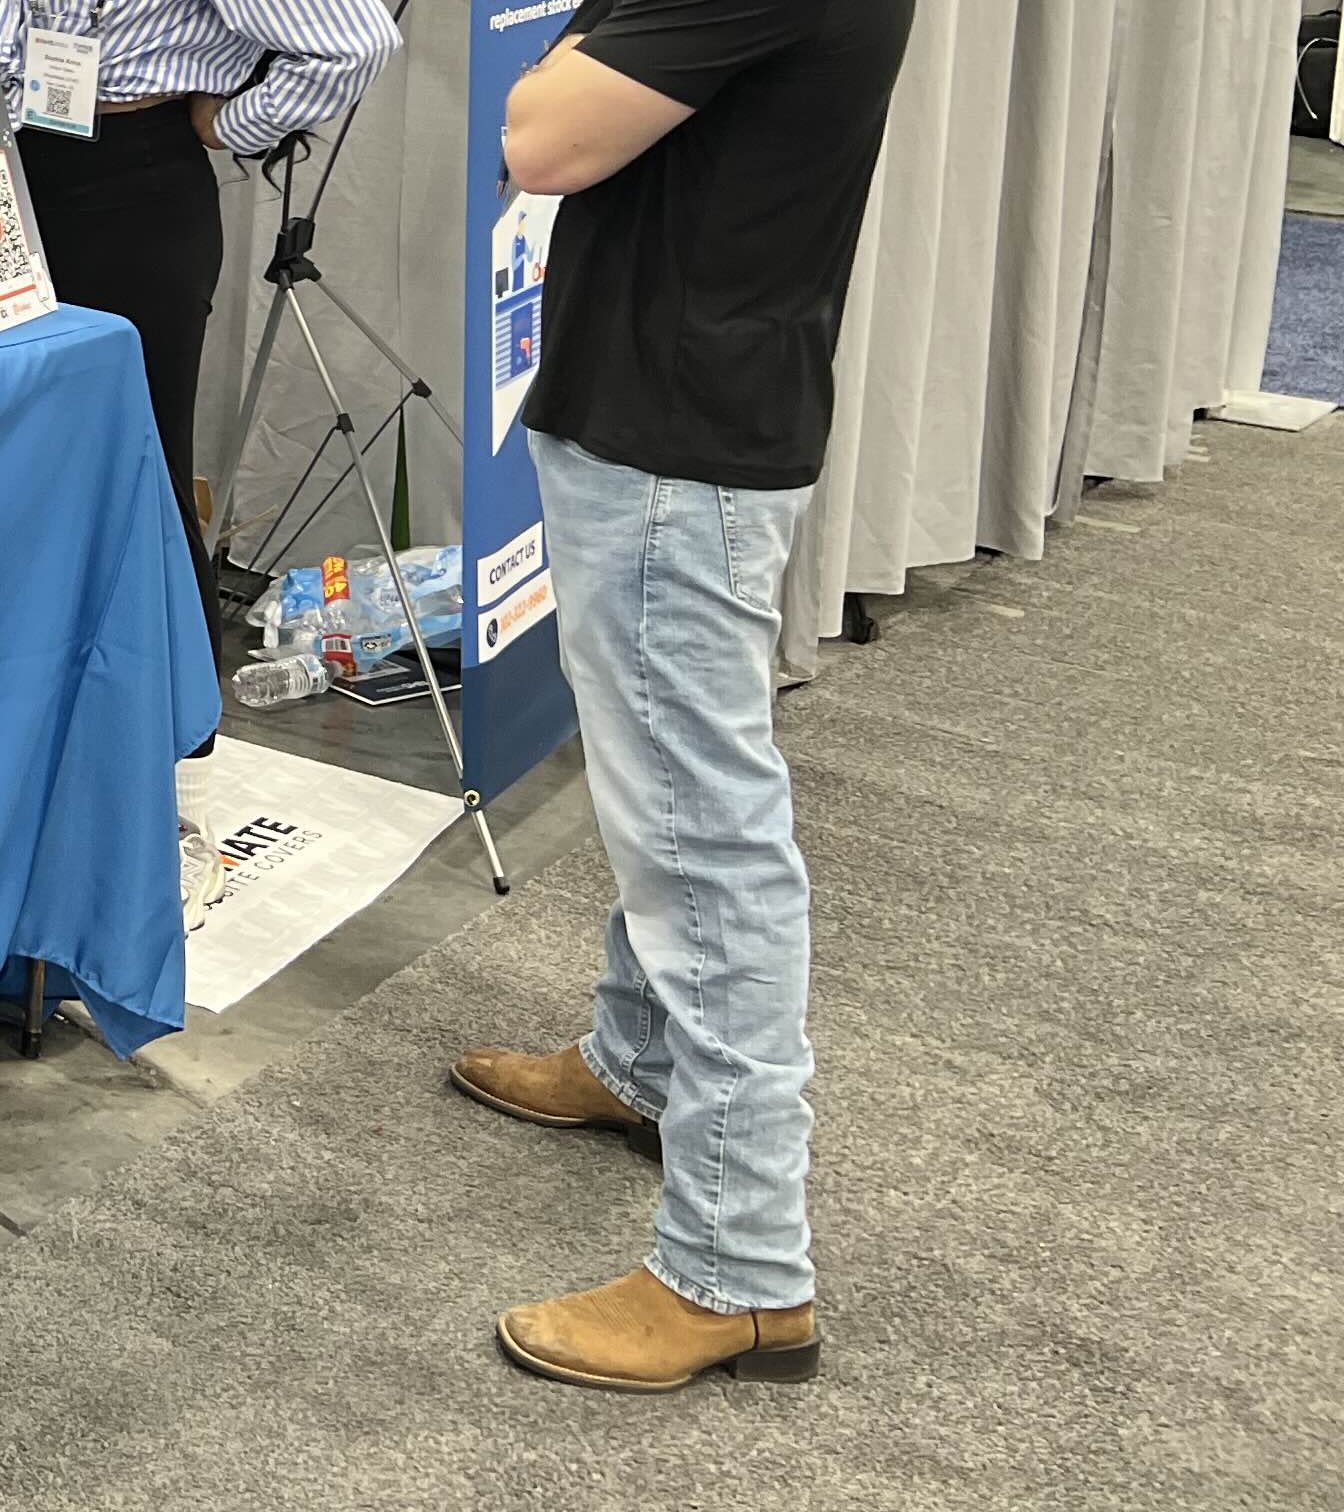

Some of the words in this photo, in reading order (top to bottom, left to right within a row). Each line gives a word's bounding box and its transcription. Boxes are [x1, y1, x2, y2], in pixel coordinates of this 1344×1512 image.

[489, 0, 548, 33] replacement
[489, 547, 524, 585] CONTACT
[525, 539, 536, 560] US
[261, 828, 324, 875] COVERS
